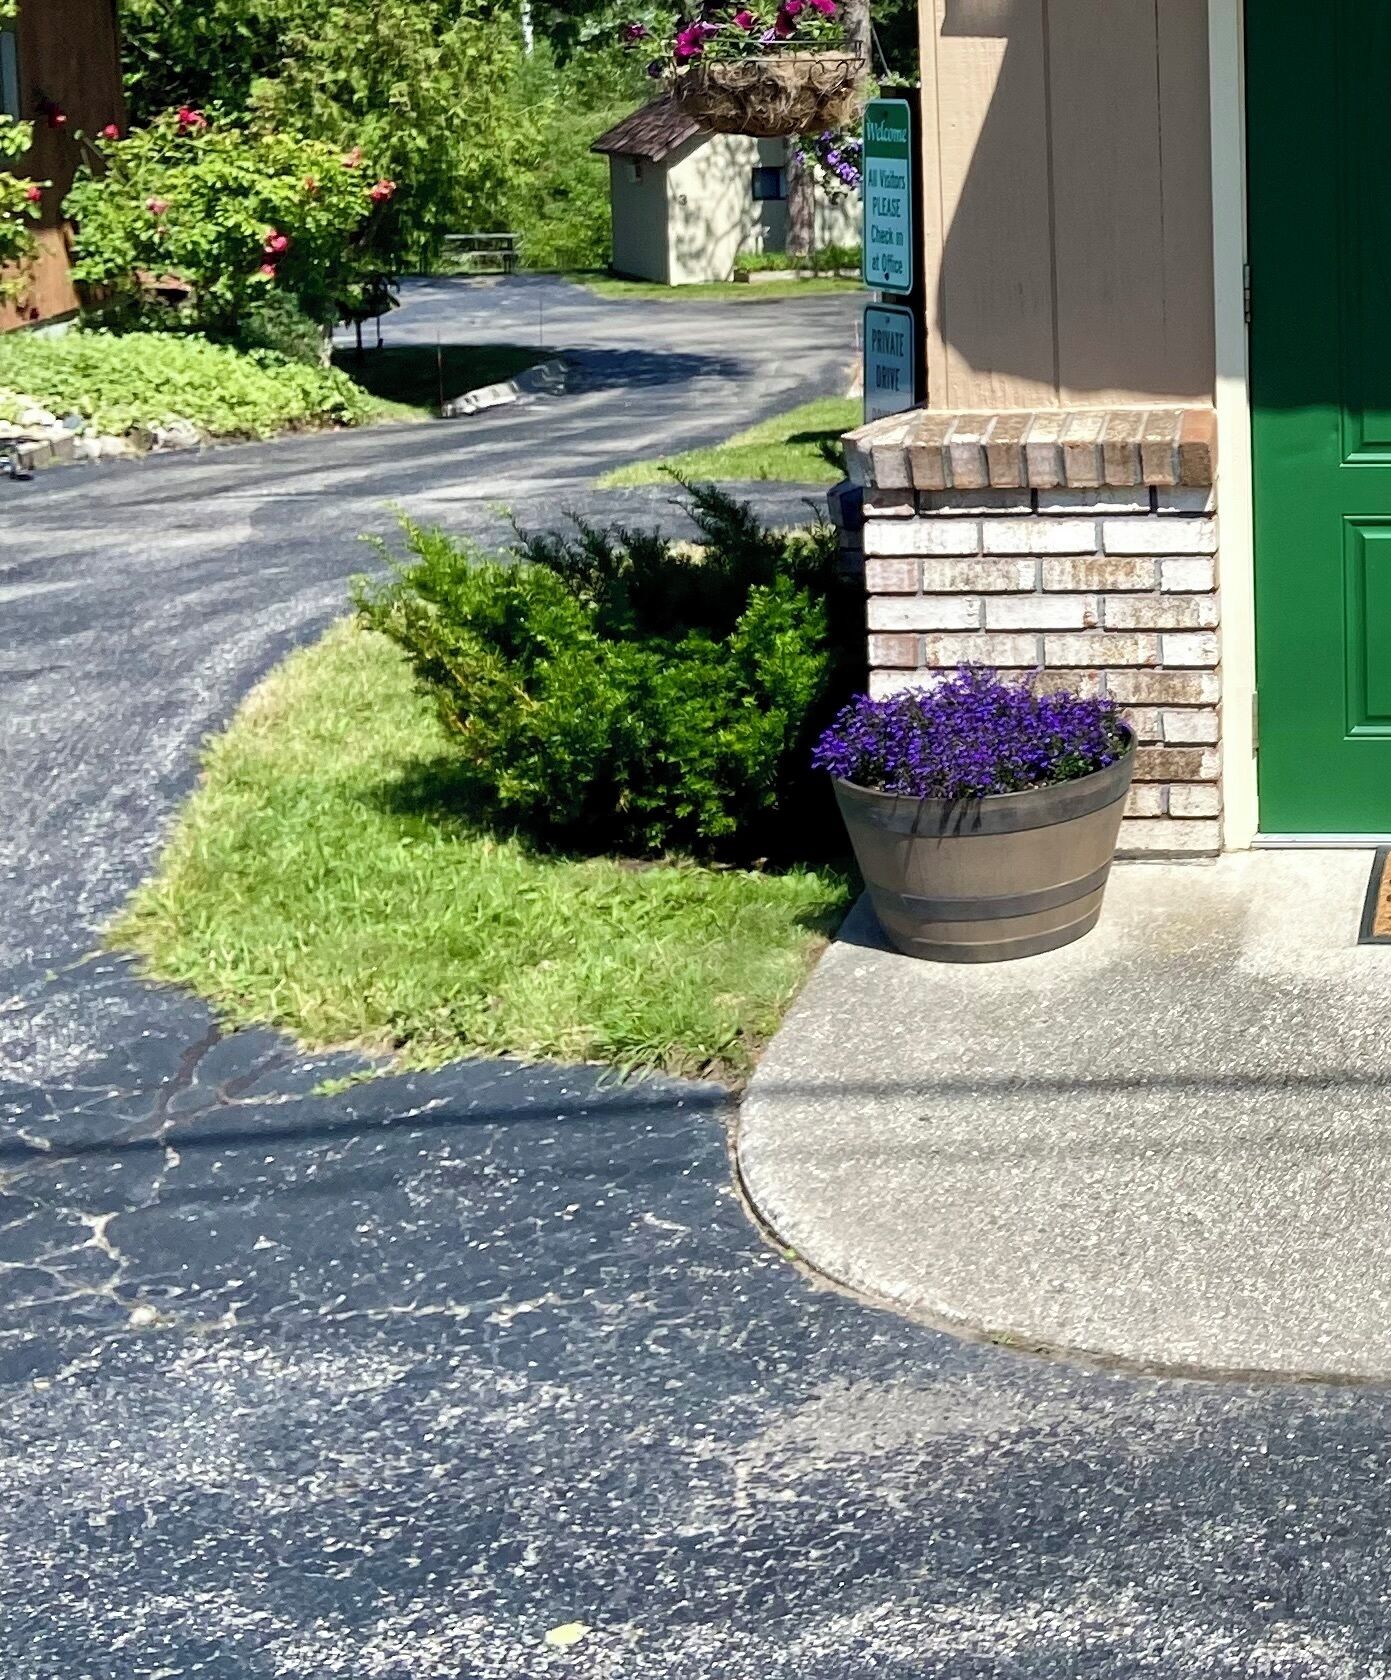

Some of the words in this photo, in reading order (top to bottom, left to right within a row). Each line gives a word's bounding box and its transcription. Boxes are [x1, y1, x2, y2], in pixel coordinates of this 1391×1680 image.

[866, 119, 907, 143] Welcome
[868, 168, 878, 188] All
[879, 169, 906, 190] Visitors
[679, 194, 688, 206] 3
[872, 196, 901, 218] PLEASE
[871, 223, 894, 245] Check
[872, 254, 880, 271] at
[881, 252, 903, 275] Office
[871, 328, 904, 357] PRIVATE
[875, 365, 900, 392] DRIVE
